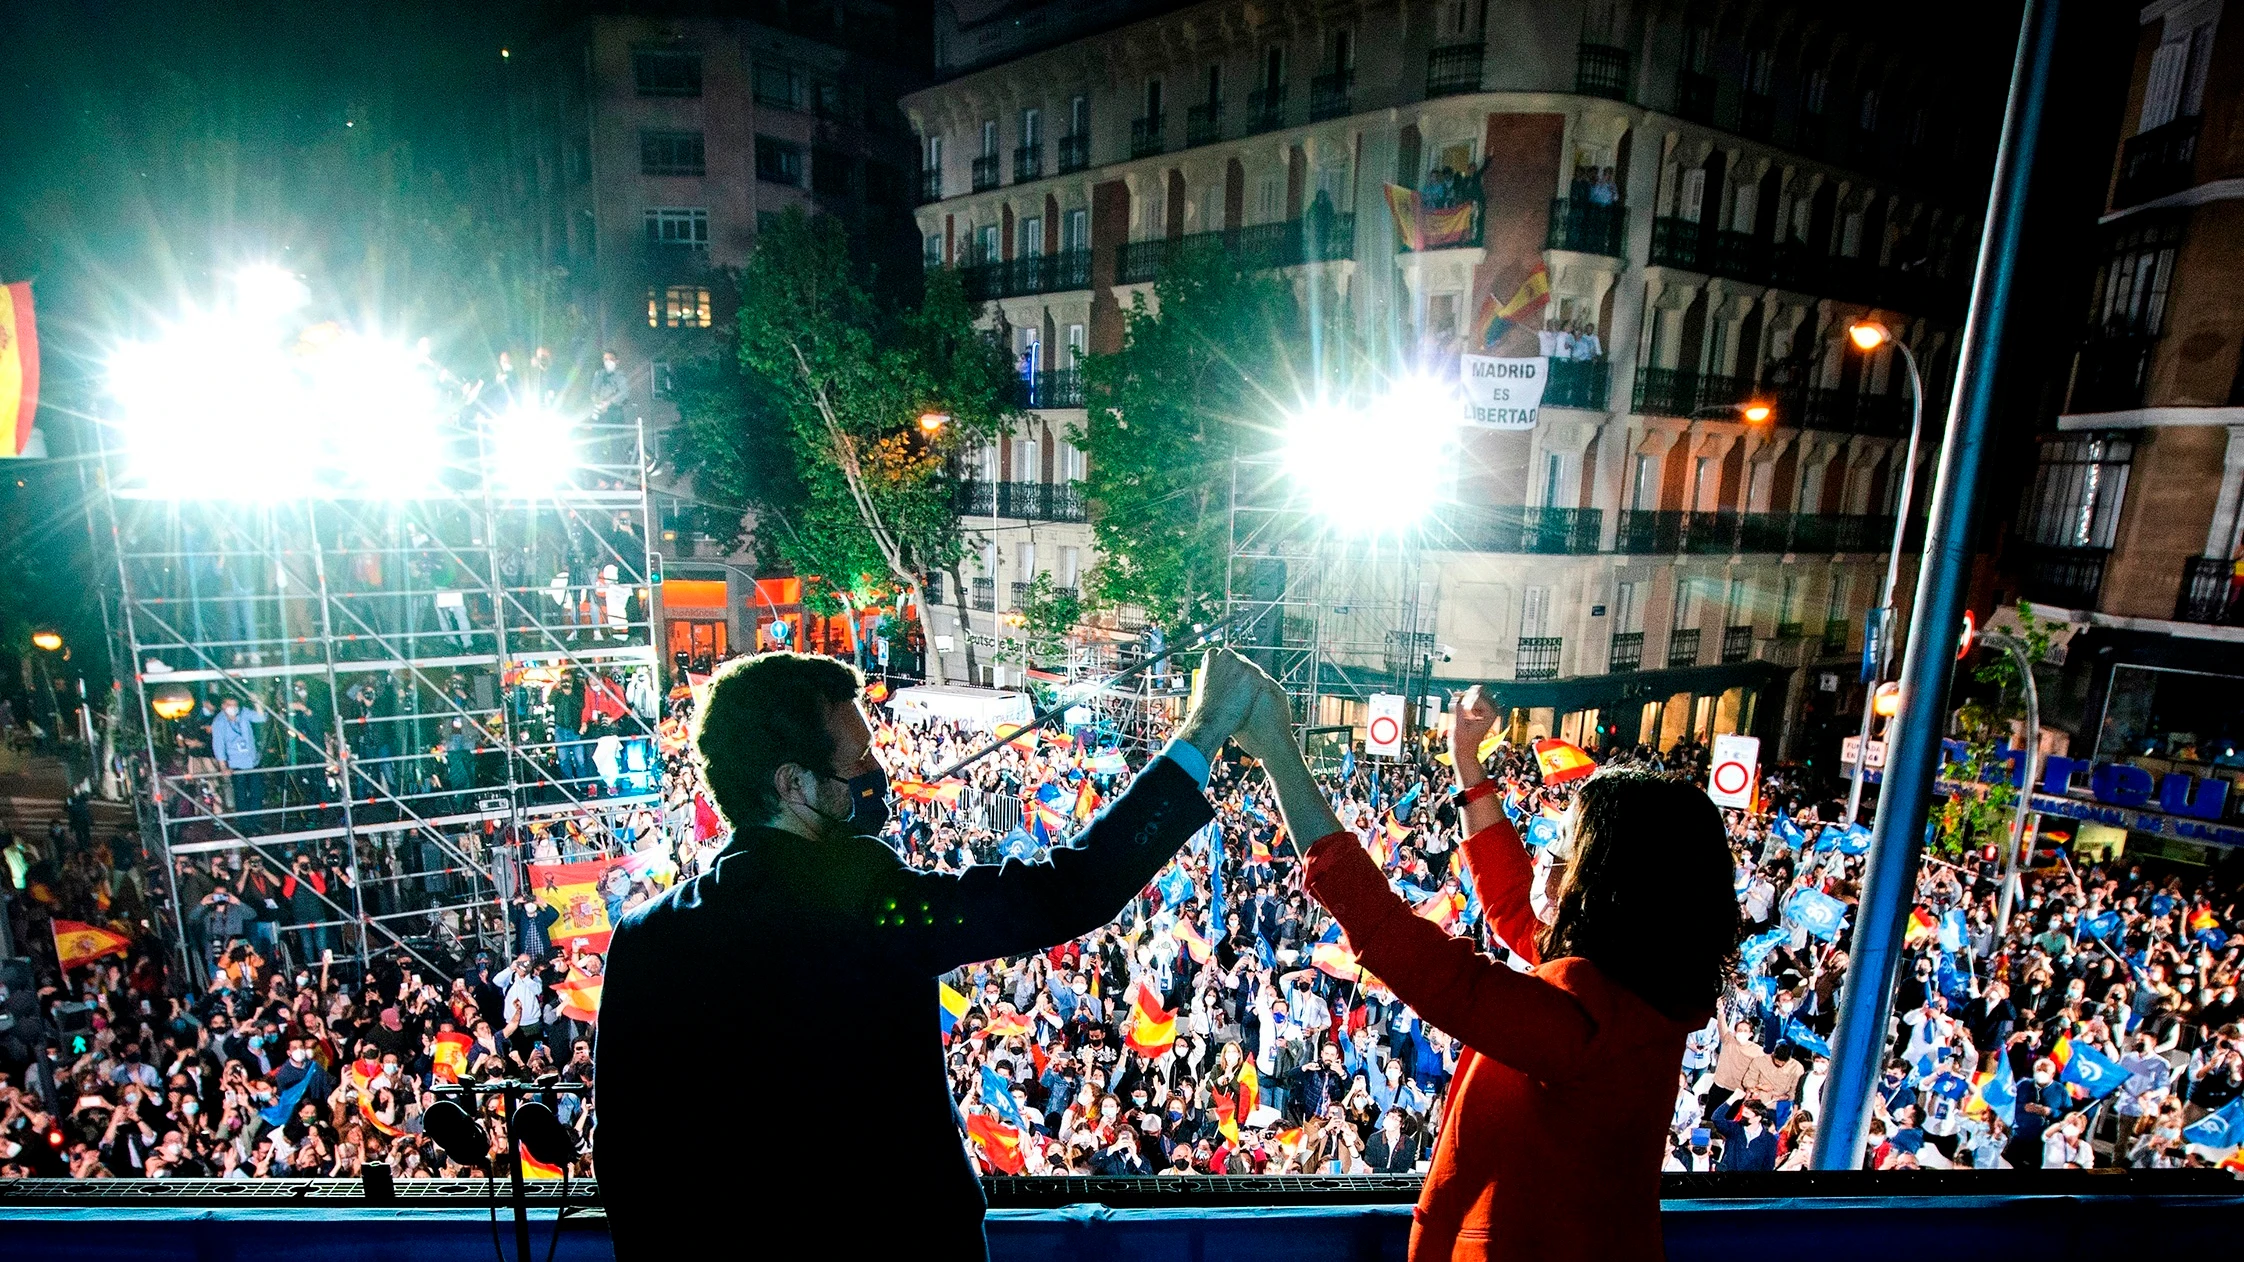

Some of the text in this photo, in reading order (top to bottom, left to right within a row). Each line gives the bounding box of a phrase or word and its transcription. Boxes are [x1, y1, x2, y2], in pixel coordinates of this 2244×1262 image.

[1472, 362, 1536, 379] MADRID
[1493, 388, 1511, 401] ES
[1463, 404, 1537, 424] LIBERTAD
[964, 628, 1007, 650] Deutsce
